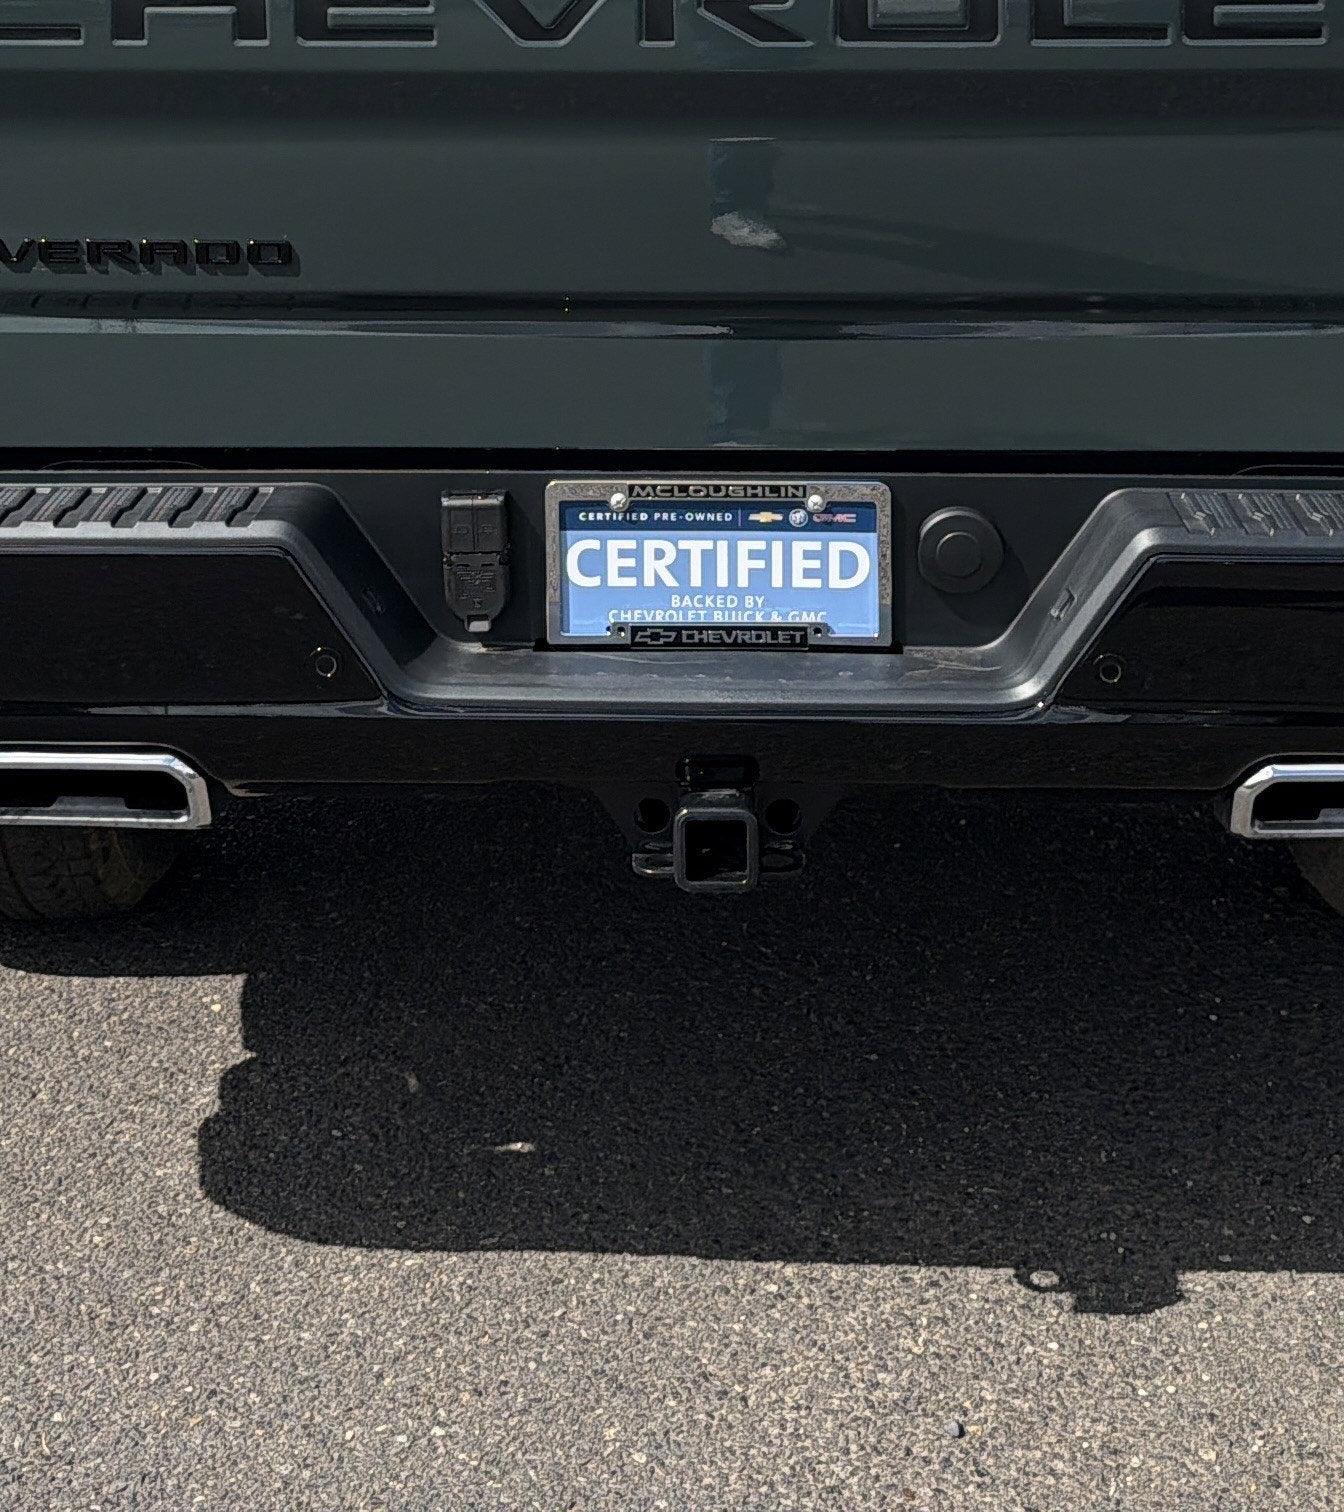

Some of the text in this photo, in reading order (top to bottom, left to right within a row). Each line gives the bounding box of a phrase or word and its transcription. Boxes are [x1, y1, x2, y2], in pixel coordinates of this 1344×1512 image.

[578, 512, 648, 521] CERTIFIED
[654, 512, 733, 522] PRE-OWNED
[566, 539, 871, 589] CERTIFIED
[671, 594, 765, 608] BACKED BY
[608, 609, 707, 623] CHEVROLET
[788, 611, 827, 622] GMC
[682, 629, 805, 643] CHEVROLET
